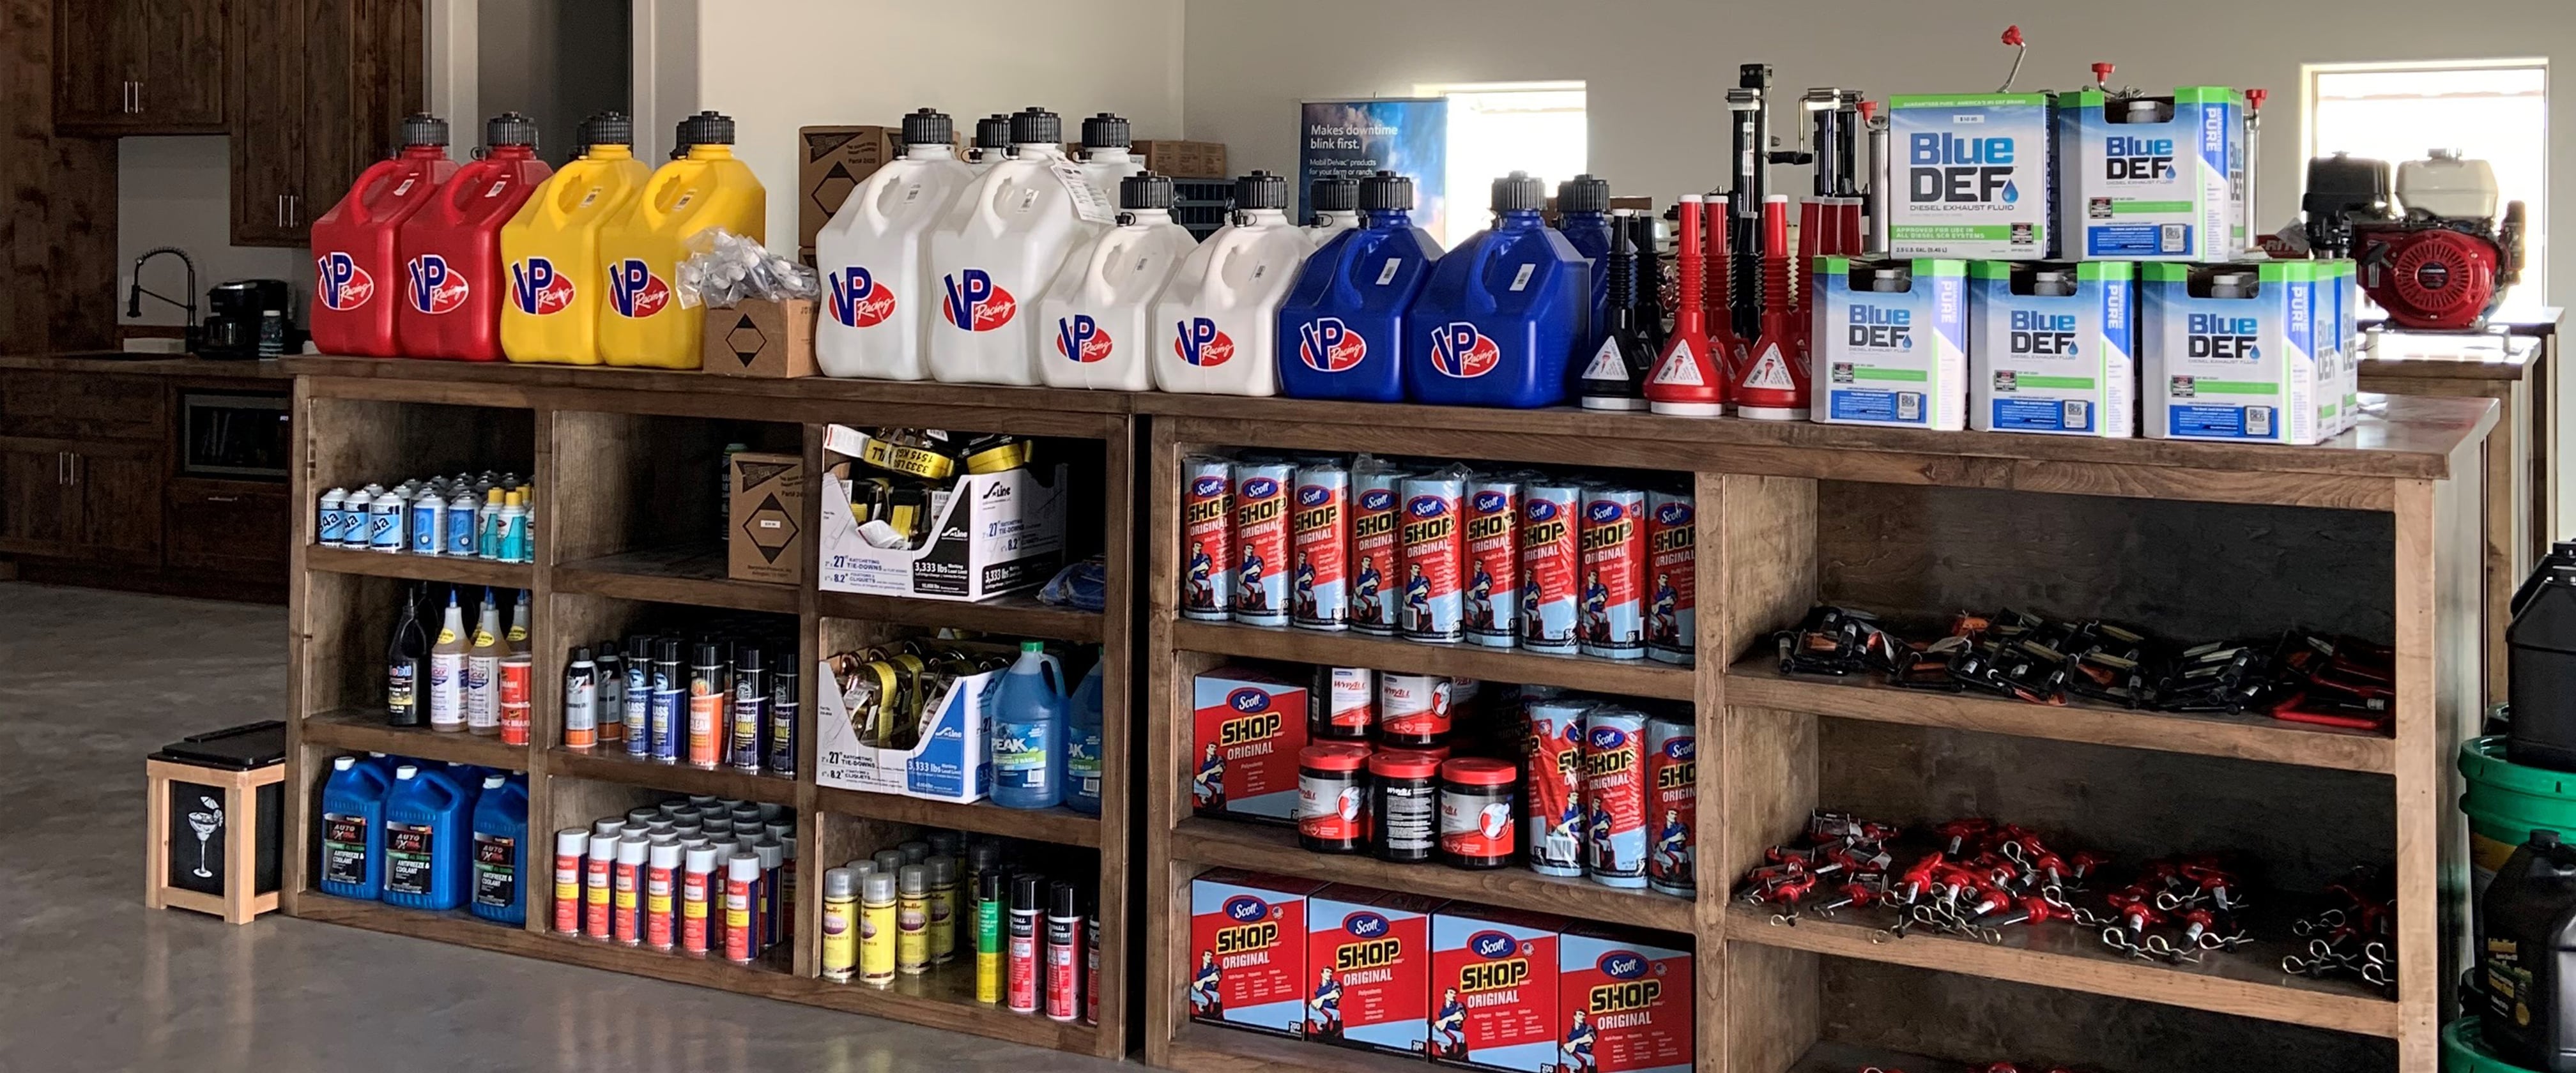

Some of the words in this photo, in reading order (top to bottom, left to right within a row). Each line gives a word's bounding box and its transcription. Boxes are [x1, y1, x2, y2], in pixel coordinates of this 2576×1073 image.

[1311, 125, 1343, 135] Makes
[1346, 125, 1398, 135] downtime
[2205, 107, 2217, 152] PURE
[1310, 139, 1335, 149] blink
[1337, 139, 1360, 149] first.
[1910, 132, 2014, 165] Blue
[2106, 137, 2173, 156] Blue
[1350, 159, 1376, 167] products
[2106, 157, 2173, 179] DEF
[1910, 166, 2014, 202] DEF
[318, 252, 354, 310] VP
[341, 282, 372, 302] Racing
[408, 254, 447, 314] VP
[433, 285, 468, 305] Racing
[510, 257, 555, 314] VP
[539, 288, 574, 307] Racing
[608, 258, 650, 317] VP
[635, 290, 670, 310] Racing
[829, 266, 873, 328] VP
[857, 298, 895, 319] Racing
[943, 268, 993, 331] VP
[975, 301, 1016, 324] Racing
[1941, 280, 1952, 323] PURE
[1850, 304, 1910, 325] Blue
[2108, 285, 2119, 330] PURE
[2292, 286, 2303, 332] PURE
[2011, 310, 2076, 331] Blue
[2188, 313, 2258, 334] Blue
[1059, 314, 1096, 362] VP
[1082, 340, 1112, 356] Racing
[1177, 317, 1216, 366] VP
[1202, 344, 1234, 360] Racing
[1300, 317, 1345, 370] VP
[1331, 343, 1365, 364] Racing
[1849, 325, 1910, 347] DEF
[2011, 331, 2076, 354] DEF
[1431, 322, 1478, 376] VP
[1462, 349, 1498, 369] Racing
[2188, 335, 2258, 359] DEF
[910, 450, 933, 462] 1515
[906, 462, 929, 473] 3333
[1197, 480, 1218, 496] Scott
[1248, 482, 1270, 498] Scott
[1302, 489, 1321, 505] Scott
[1187, 493, 1235, 524] SHOP
[1238, 496, 1288, 527] SHOP
[1367, 494, 1388, 509] Scott
[1416, 500, 1437, 515] Scott
[1478, 496, 1499, 510] Scott
[1295, 505, 1338, 533] SHOP
[1529, 505, 1547, 519] Scott
[1593, 506, 1613, 521] Scott
[1661, 506, 1683, 524] Scott
[1190, 517, 1228, 536] ORIGINAL
[1241, 520, 1279, 538] ORIGINAL
[1356, 510, 1400, 538] SHOP
[1404, 515, 1456, 546] SHOP
[1467, 510, 1517, 541] SHOP
[1358, 532, 1398, 551] ORIGINAL
[1471, 536, 1510, 553] ORIGINAL
[1583, 519, 1634, 552] SHOP
[1653, 525, 1695, 555] SHOP
[1407, 539, 1448, 558] ORIGINAL
[1584, 545, 1627, 565] ORIGINAL
[915, 561, 936, 573] 3,333
[937, 563, 947, 574] lbs
[985, 568, 1000, 583] 3,333
[1001, 568, 1009, 579] lbs
[1238, 693, 1261, 710] Scott
[1220, 712, 1282, 747] SHOP
[1595, 731, 1615, 747] Scott
[992, 738, 1029, 753] PEAK
[1227, 741, 1274, 761] ORIGINAL
[1671, 741, 1695, 758] Scott
[842, 759, 875, 768] TIE-DOWNS
[908, 761, 929, 772] 3,333
[930, 762, 941, 773] lbs
[1587, 747, 1635, 777] SHOP
[1590, 773, 1629, 790] ORIGINAL
[334, 850, 359, 858] ANTIFREEZE
[397, 860, 424, 869] ANTIFREEZE
[482, 878, 501, 887] COOLANT
[483, 872, 507, 881] ANTIFREEZE
[1234, 902, 1259, 918] Scott
[1355, 918, 1379, 935] Scott
[1216, 921, 1278, 955] SHOP
[1480, 937, 1506, 955] Scott
[1222, 950, 1270, 970] ORIGINAL
[1336, 938, 1401, 971] SHOP
[1459, 957, 1529, 993] SHOP
[1611, 958, 1637, 976] Scott
[1343, 968, 1393, 987] ORIGINAL
[1468, 989, 1519, 1008] ORIGINAL
[1589, 978, 1661, 1015] SHOP
[1597, 1010, 1652, 1031] ORIGINAL
